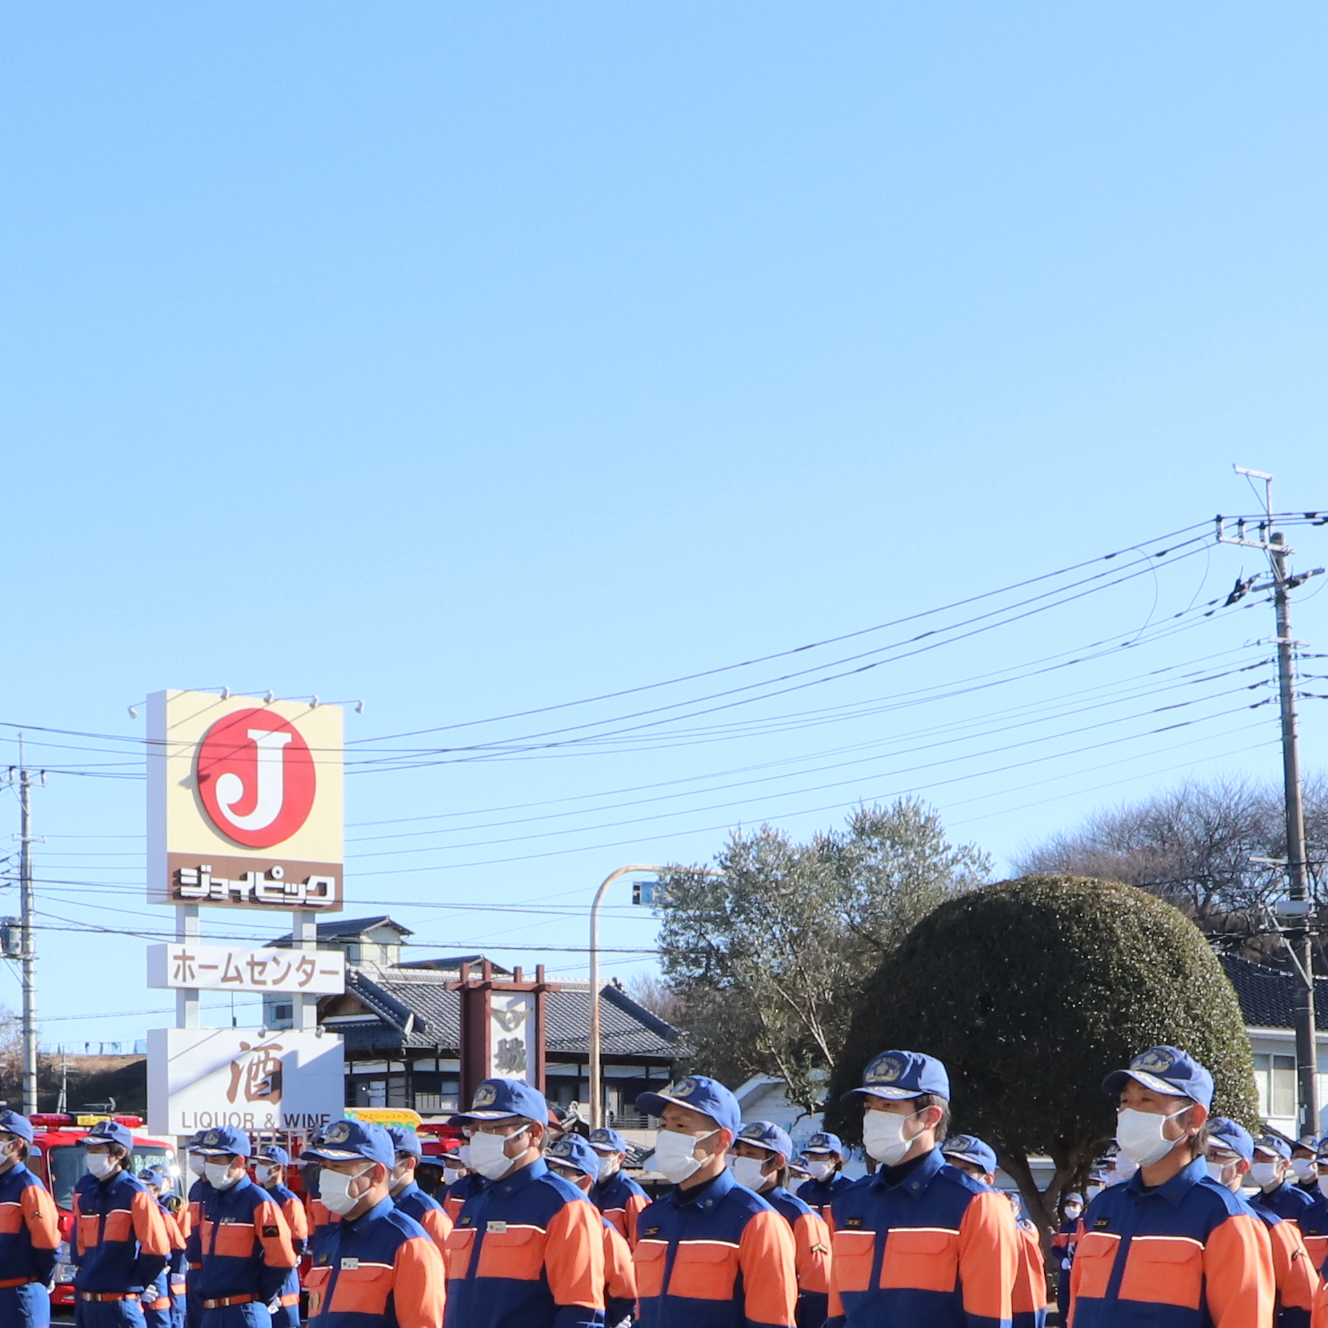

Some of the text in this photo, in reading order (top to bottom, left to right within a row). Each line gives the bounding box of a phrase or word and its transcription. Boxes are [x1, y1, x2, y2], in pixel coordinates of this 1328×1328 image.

[215, 728, 293, 831] J
[178, 864, 336, 906] ジョイピック
[172, 948, 340, 988] ホームセンター
[225, 1040, 284, 1105] 酒
[181, 1111, 331, 1129] LIQUOR & WINE
[358, 1111, 416, 1121] ファミリーレストラン
